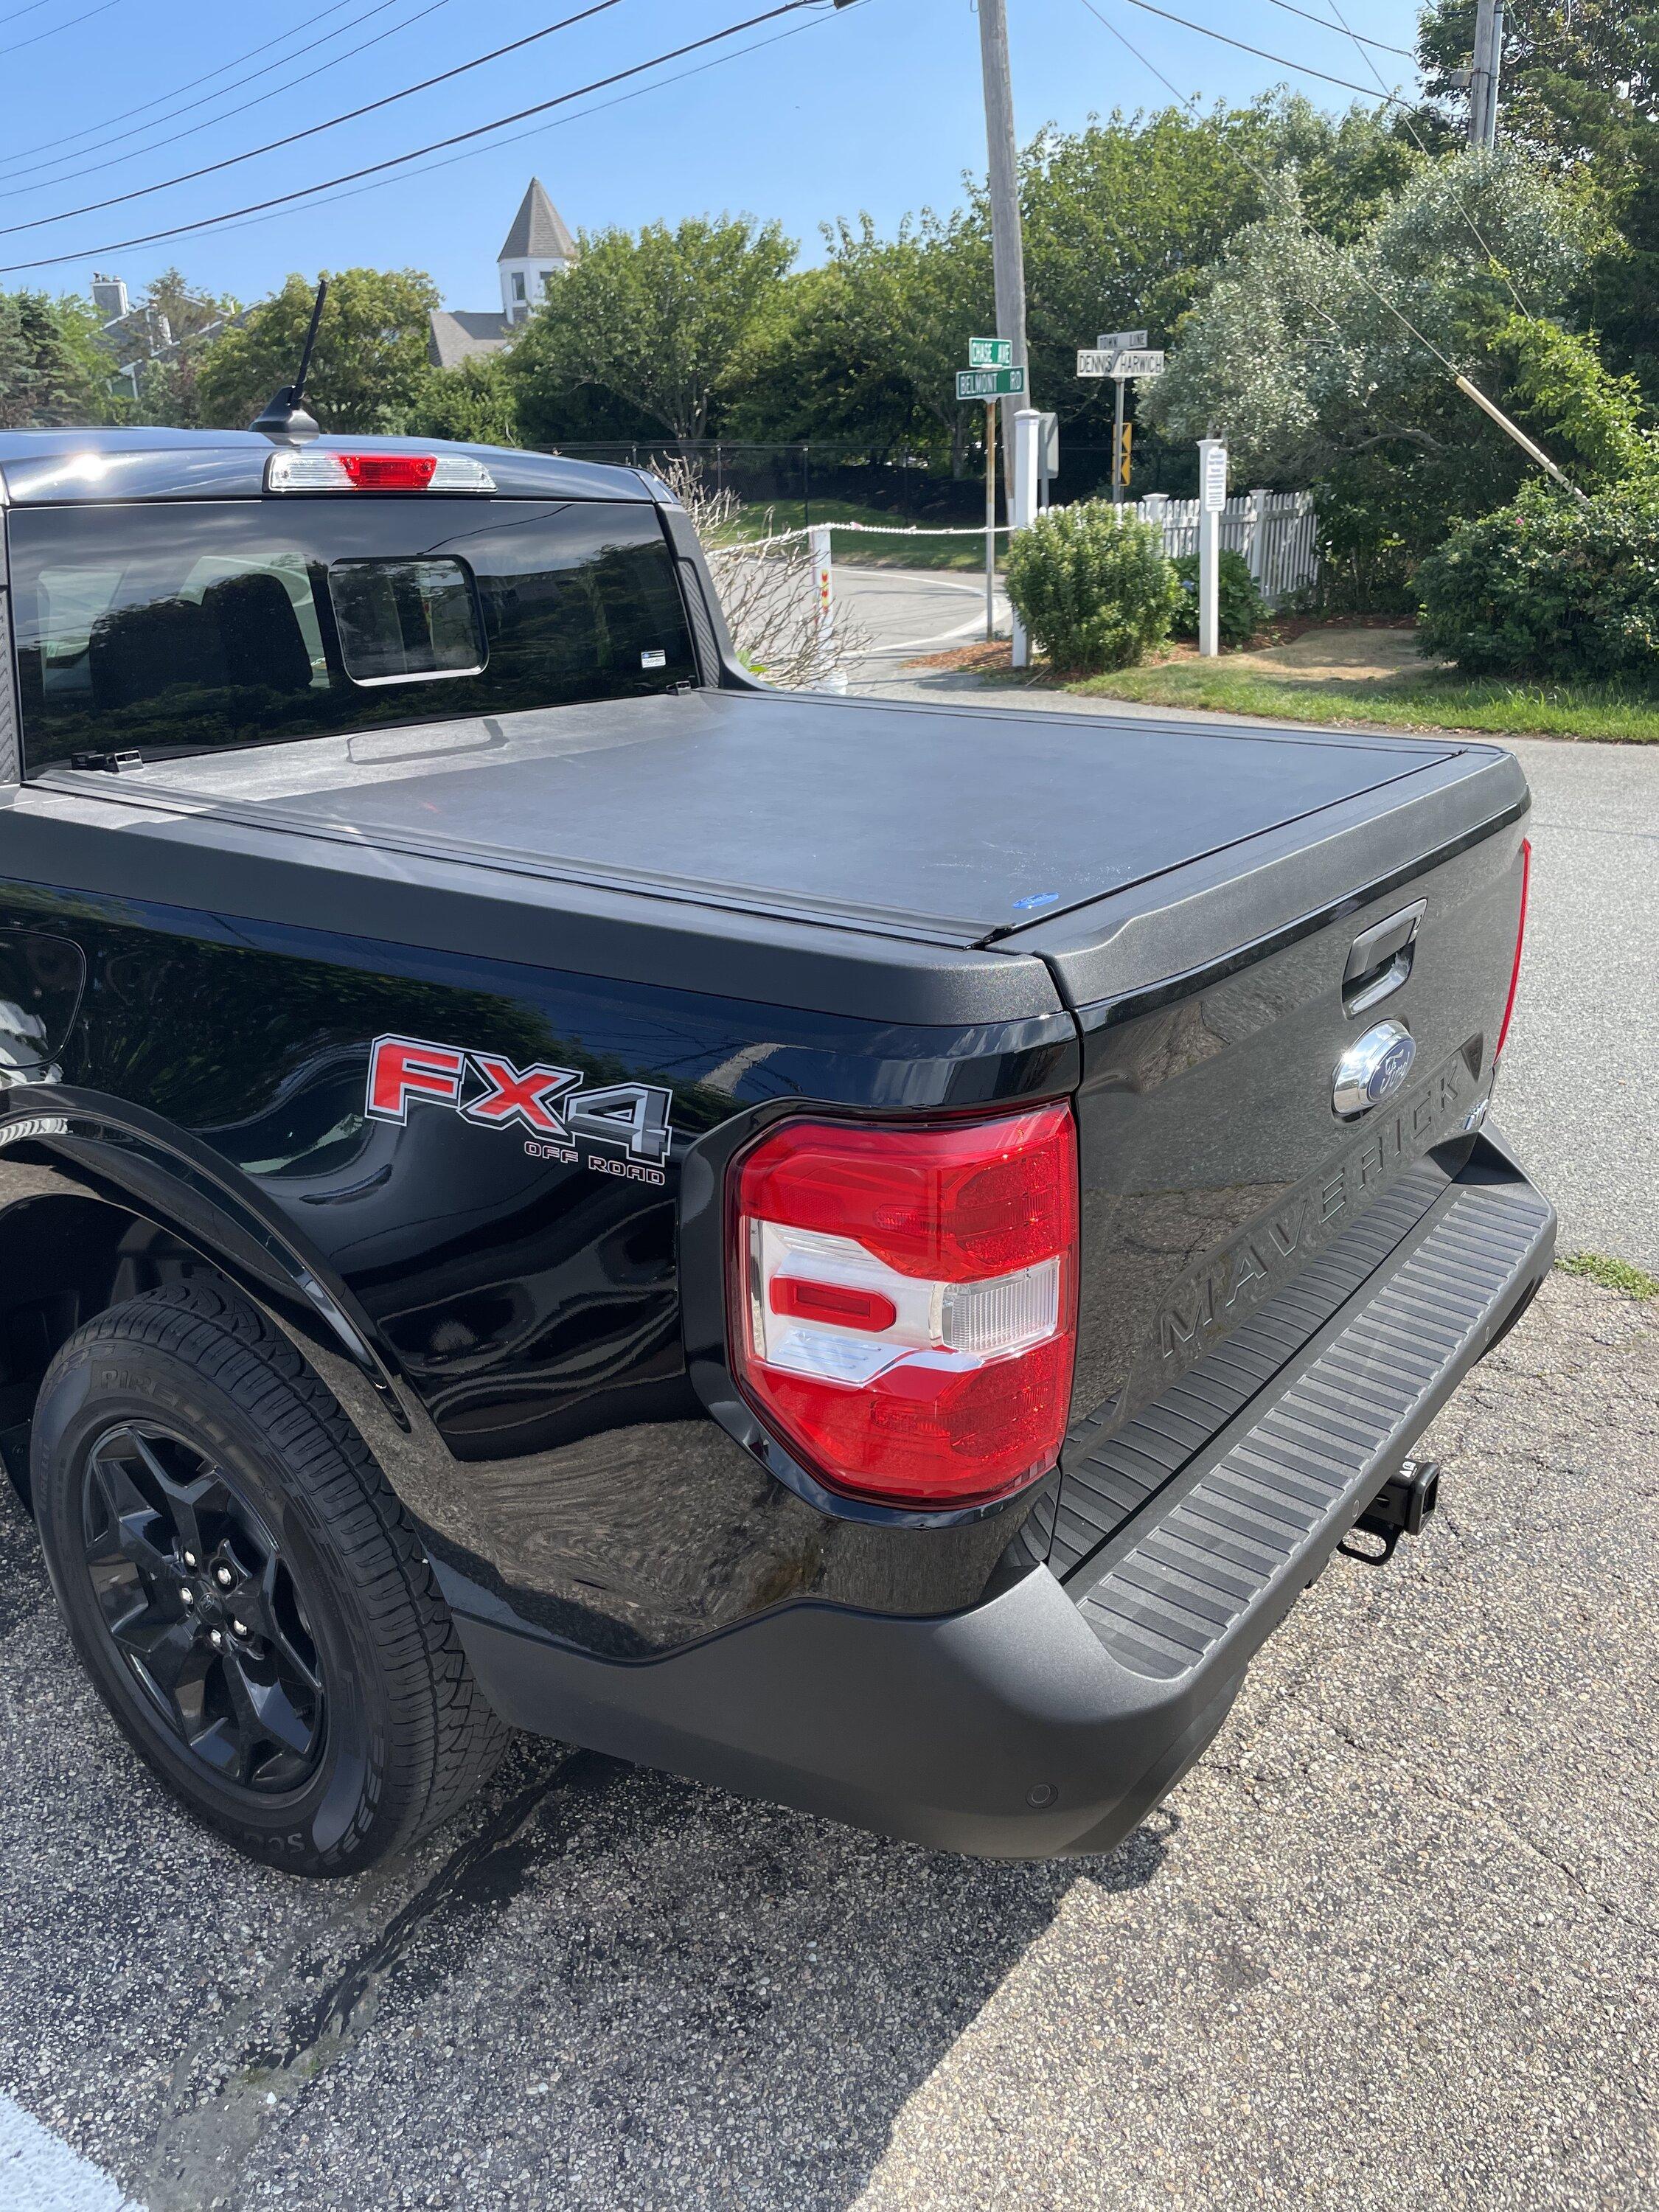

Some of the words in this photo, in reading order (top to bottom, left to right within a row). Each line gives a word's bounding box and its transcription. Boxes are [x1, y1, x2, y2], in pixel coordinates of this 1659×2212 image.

[972, 342, 992, 363] CHASE
[998, 344, 1010, 364] AVE
[1099, 336, 1118, 349] TOWN
[1130, 333, 1145, 346] LINE
[1079, 355, 1112, 373] DENNIS
[1121, 355, 1163, 373] HARWICH
[960, 372, 998, 394] BELMONT
[1009, 370, 1022, 390] RD
[364, 1032, 673, 1167] FX4
[524, 1140, 579, 1164] OFF
[588, 1154, 666, 1186] ROAD
[1162, 1056, 1460, 1360] MAVERICK
[100, 1369, 262, 1488] PIRELLI
